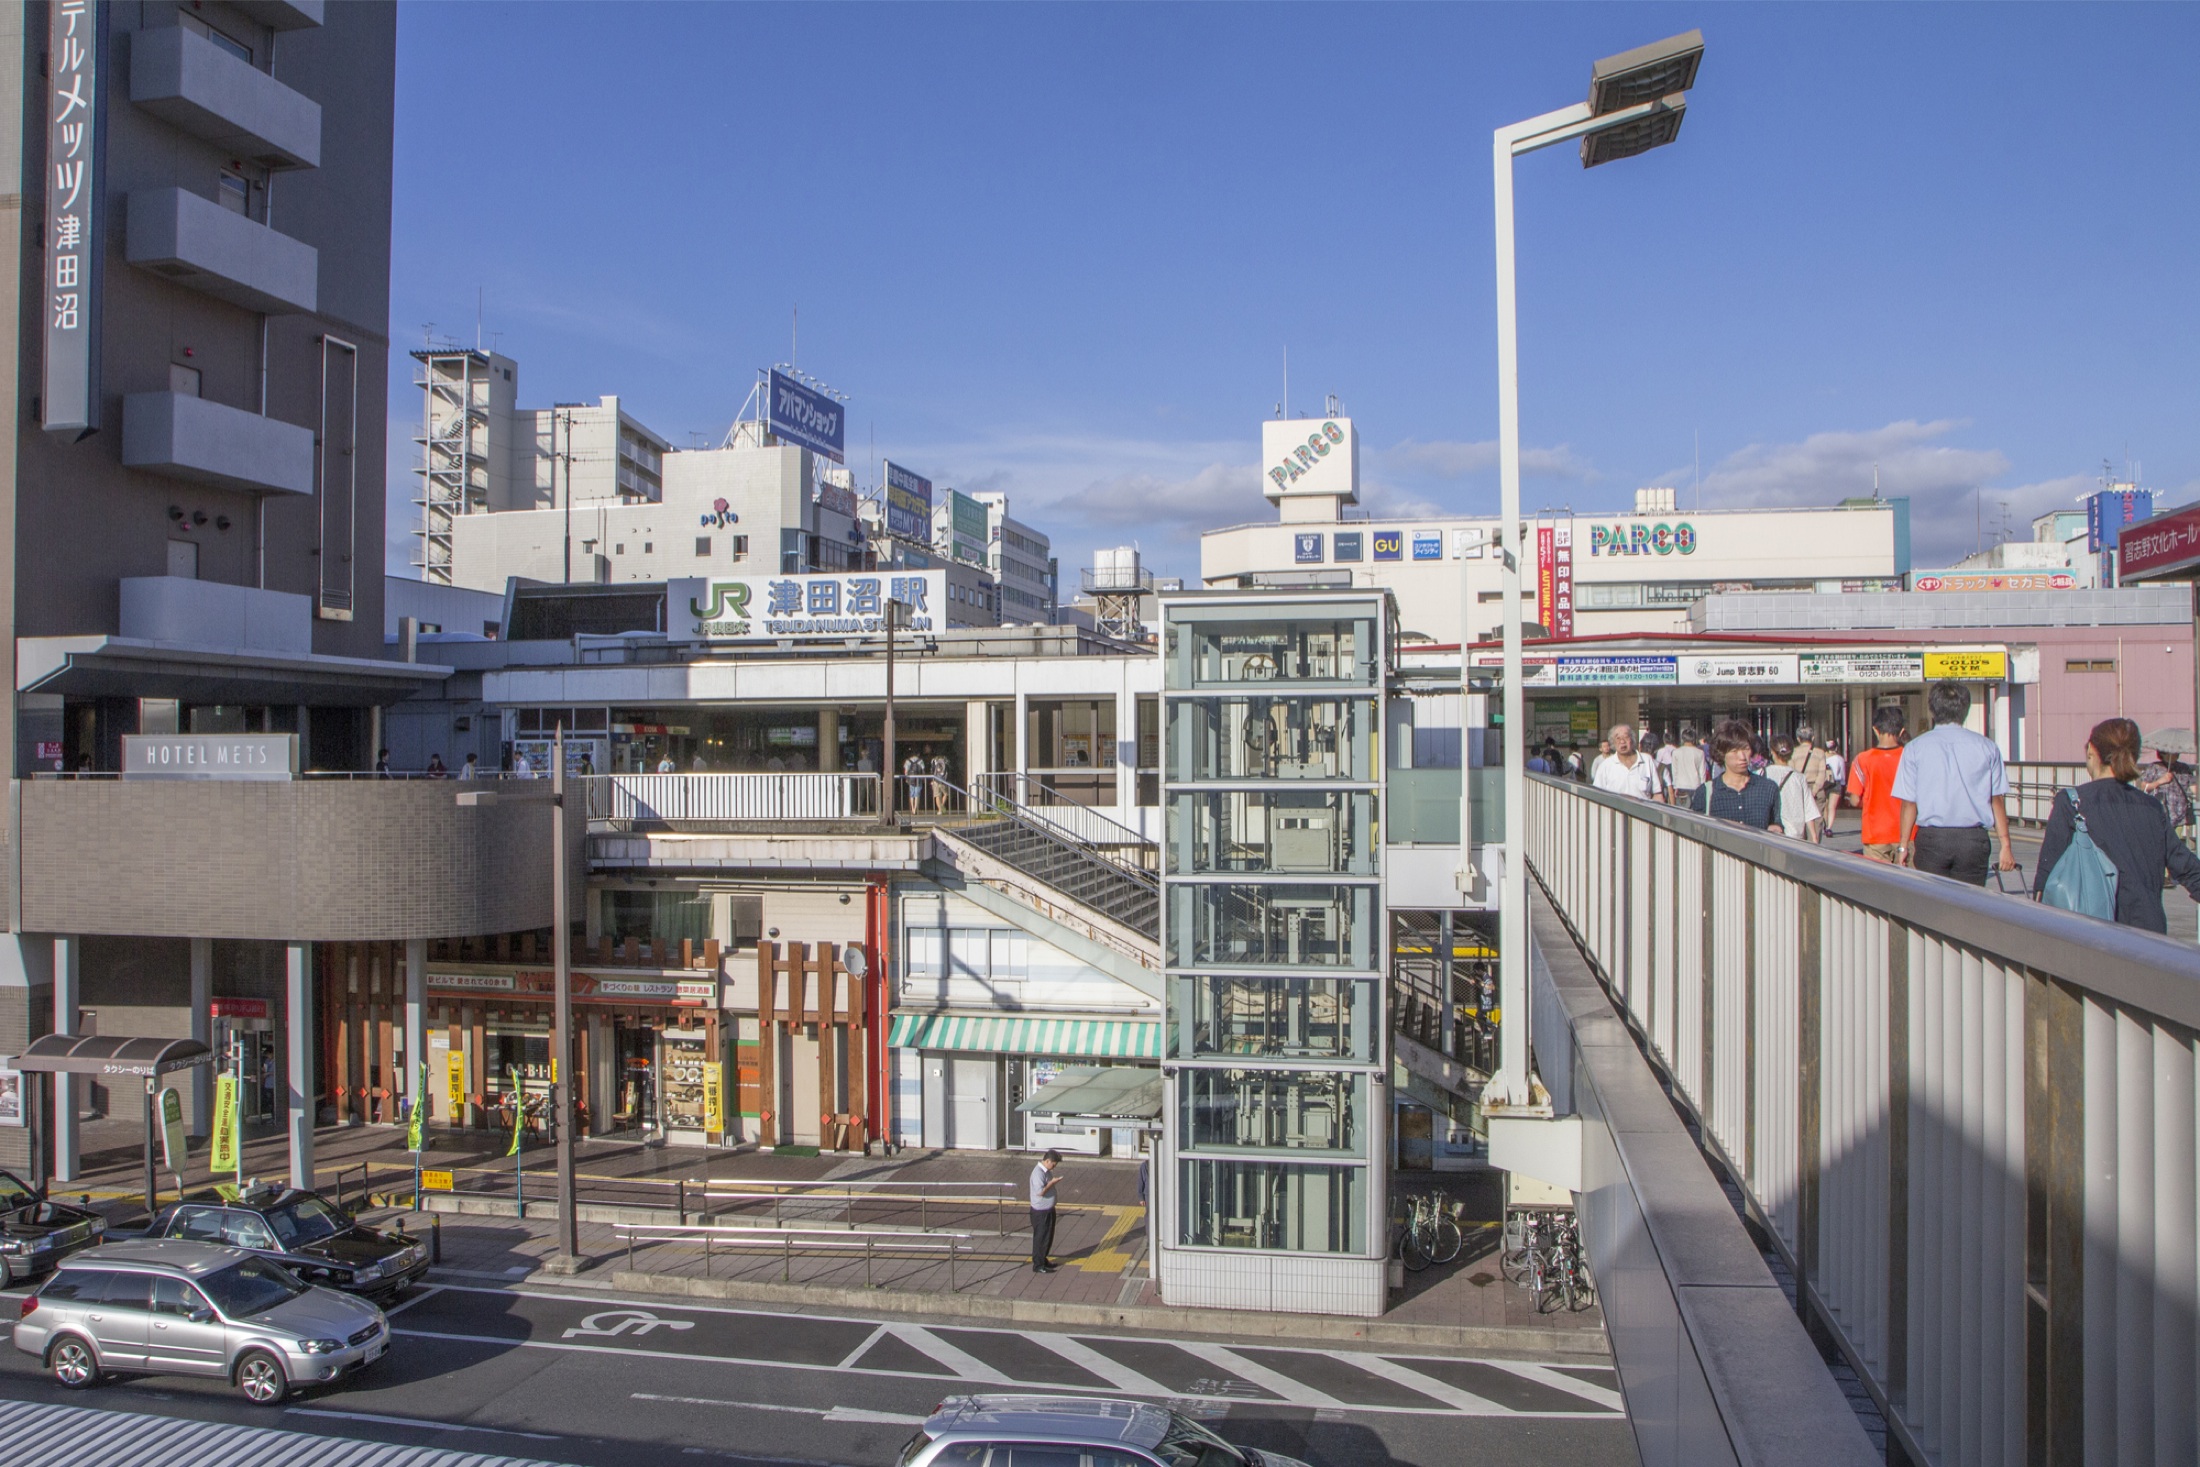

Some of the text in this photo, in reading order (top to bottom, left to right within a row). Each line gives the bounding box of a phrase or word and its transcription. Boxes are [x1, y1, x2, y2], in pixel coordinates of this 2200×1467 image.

[54, 0, 87, 330] テルメッツ津田沼
[778, 388, 837, 437] アパマンショップ
[1268, 420, 1344, 490] PARCO
[1375, 539, 1399, 553] GU
[1590, 521, 1697, 557] PARCO
[2124, 522, 2199, 564] 習志野文化ホール
[1413, 548, 1440, 556] アイシティ
[1557, 549, 1571, 610] 無印良品
[1918, 579, 1941, 590] くすり
[1942, 577, 2047, 590] ドラッグ セガミ
[2049, 576, 2075, 588] 化粧品
[766, 576, 928, 617] 津田沼駅
[1541, 569, 1551, 609] AUTUMN
[690, 582, 752, 618] JR
[691, 620, 752, 635] JR東日本
[762, 617, 863, 634] TSUDANUMA
[1558, 673, 1615, 682] 資料請求受付中
[1716, 666, 1779, 676] Jump 習志野 60
[147, 745, 268, 764] HOTEL METS
[644, 985, 673, 993] レストラン
[103, 1064, 155, 1076] タクシーのりば
[169, 1053, 213, 1070] タクシーのりば
[705, 1080, 718, 1118] 一番搾り
